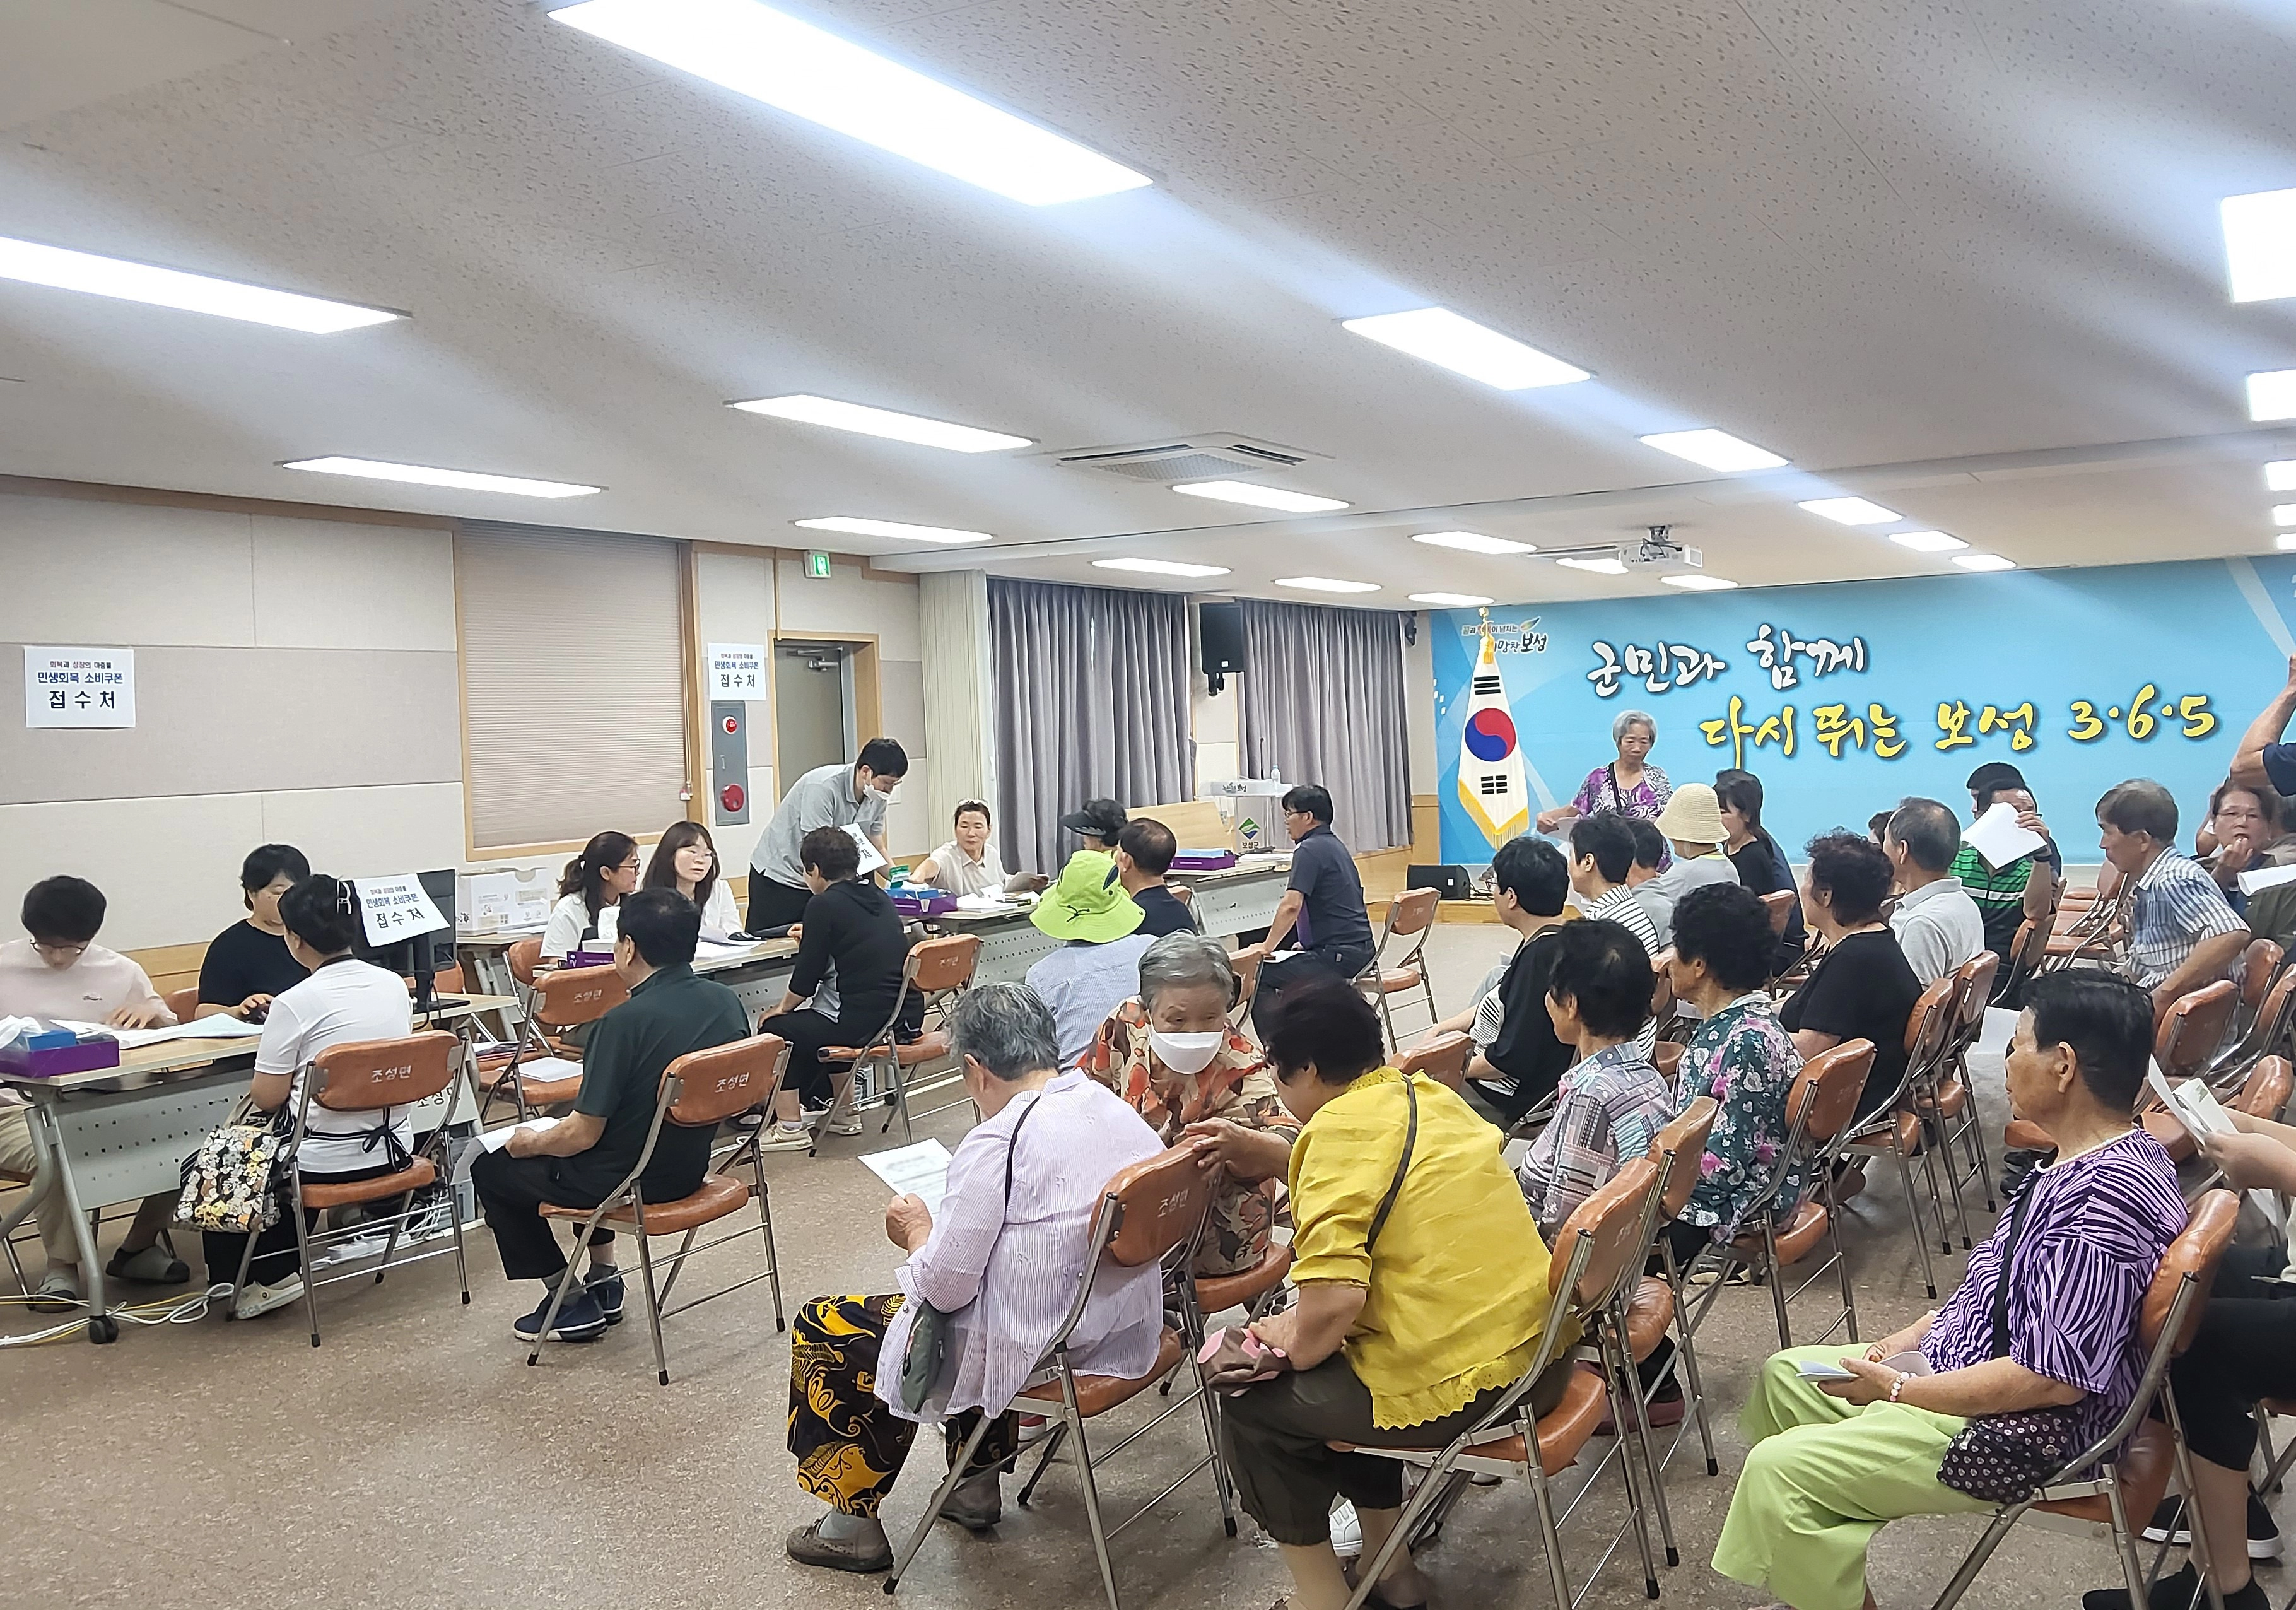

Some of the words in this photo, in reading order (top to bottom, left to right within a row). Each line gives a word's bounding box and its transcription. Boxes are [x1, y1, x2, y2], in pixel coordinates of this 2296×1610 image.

[1494, 640, 1521, 653] 망찬
[1521, 633, 1547, 652] 보성
[1587, 641, 1726, 697] 군민과
[1747, 623, 1865, 690] 함께
[38, 672, 79, 683] 민생회복
[85, 673, 123, 684] 소비쿠폰
[1699, 695, 1794, 771] 다시
[1813, 703, 1907, 758] 뛰는
[1935, 700, 2034, 751] 보성
[371, 1065, 412, 1083] 조성면
[715, 1072, 749, 1093] 조성면
